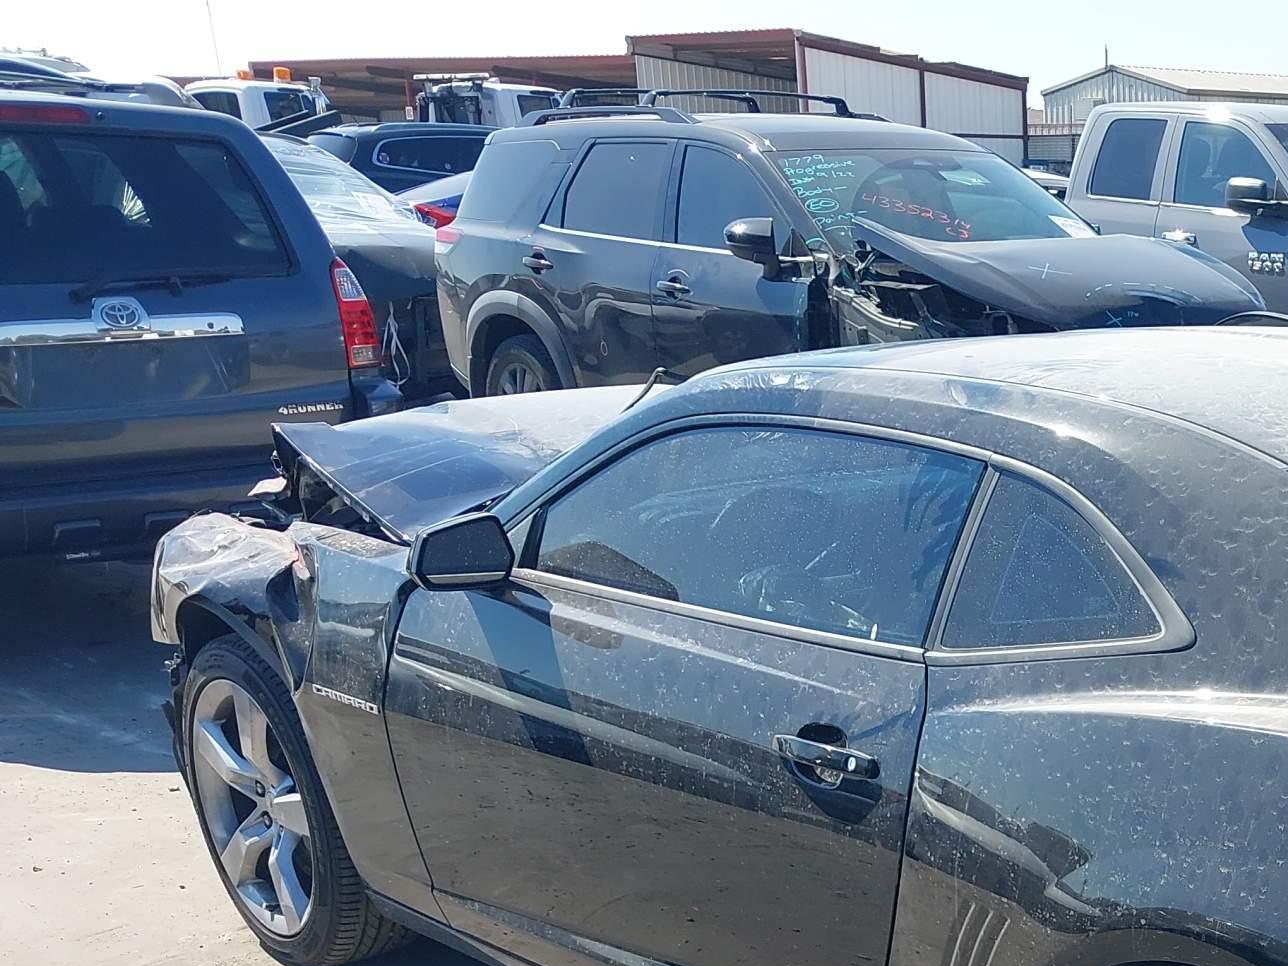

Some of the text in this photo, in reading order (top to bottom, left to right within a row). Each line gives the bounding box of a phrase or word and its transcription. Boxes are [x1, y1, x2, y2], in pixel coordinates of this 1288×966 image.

[784, 154, 824, 167] 1779
[1248, 251, 1284, 261] RAM
[278, 402, 344, 415] 4RUNNER
[312, 683, 379, 715] CAMARO
